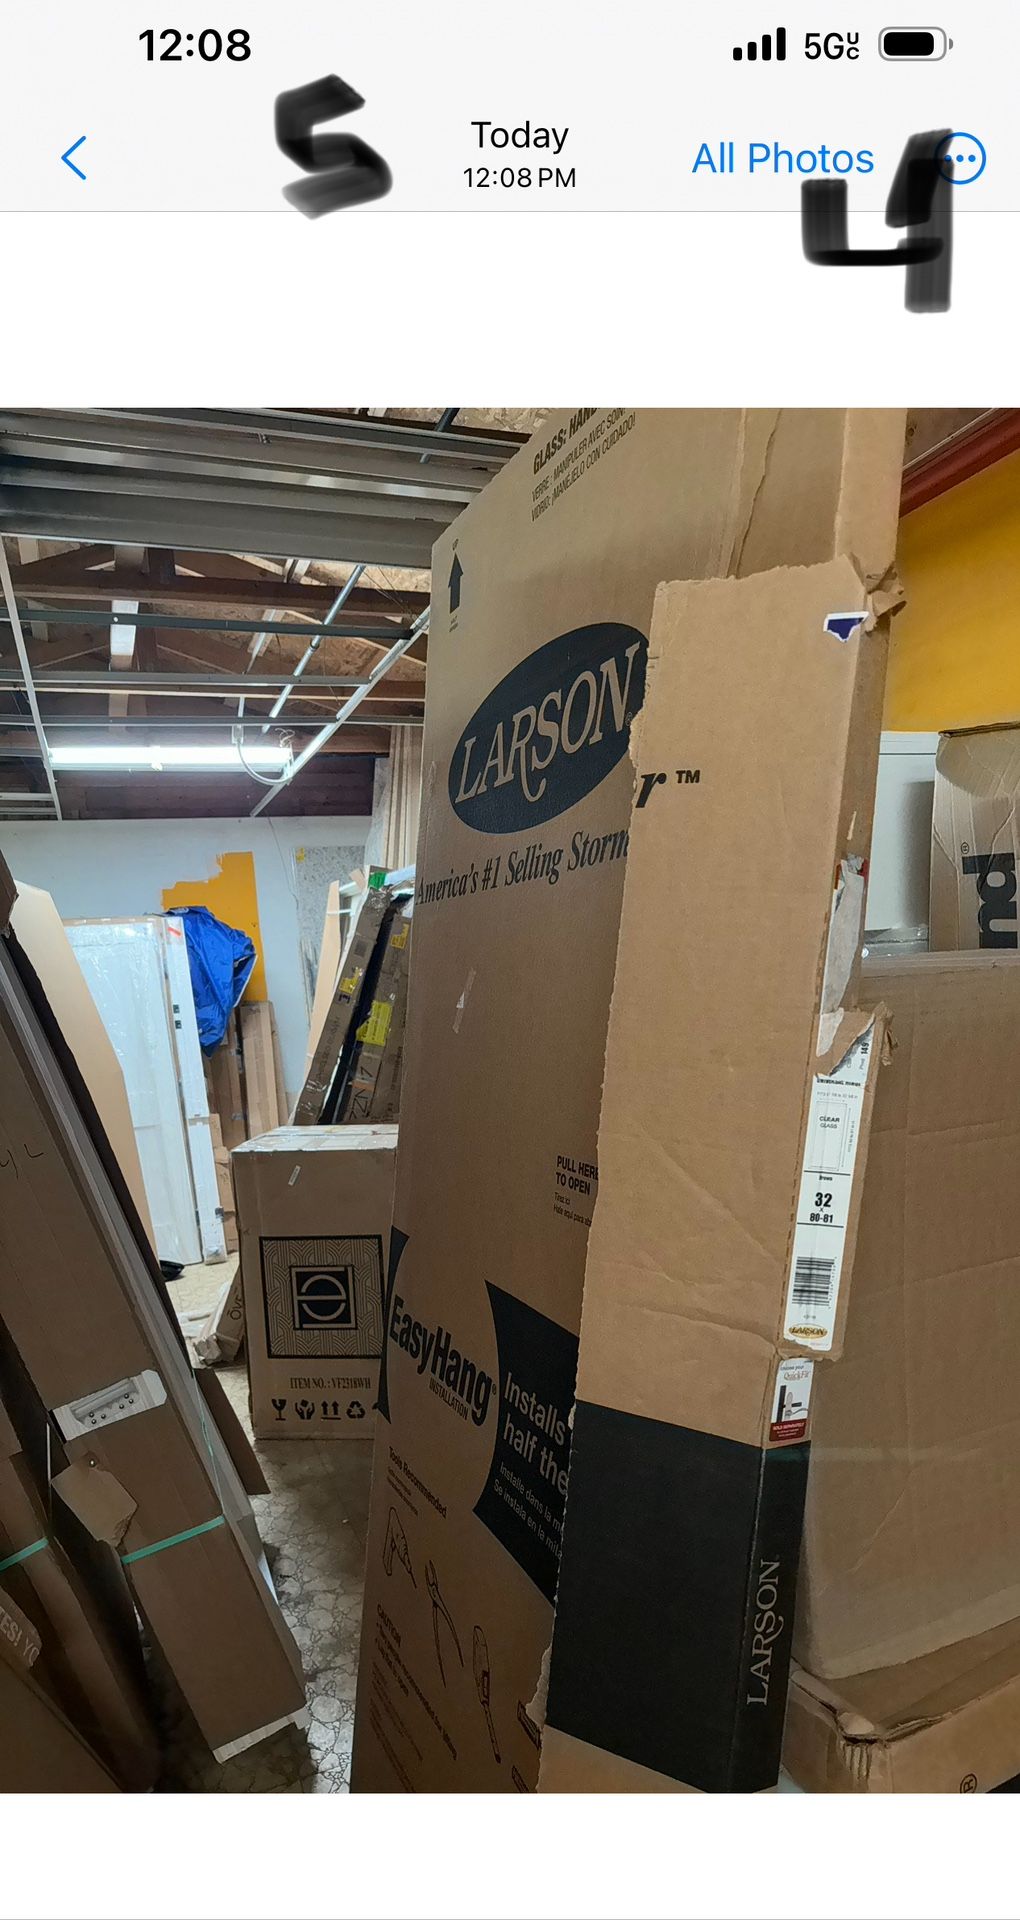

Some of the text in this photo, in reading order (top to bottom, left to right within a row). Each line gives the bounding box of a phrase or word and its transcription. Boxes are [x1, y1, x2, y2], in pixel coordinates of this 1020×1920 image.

[533, 428, 567, 475] GLASS:
[415, 862, 479, 905] America's
[481, 855, 502, 891] #1
[504, 842, 564, 886] Selling
[556, 1172, 591, 1196] TO OPEN
[557, 1155, 577, 1174] PULL
[810, 1212, 834, 1224] 80-81
[815, 1192, 833, 1208] 32
[290, 1377, 311, 1390] ITEM
[428, 1377, 469, 1422] INSTALLATION
[504, 1371, 567, 1447] Installs
[503, 1412, 569, 1496] half the
[493, 1478, 503, 1497] Se
[503, 1488, 527, 1521] instala
[527, 1515, 537, 1533] en
[746, 1558, 784, 1706] LARSON
